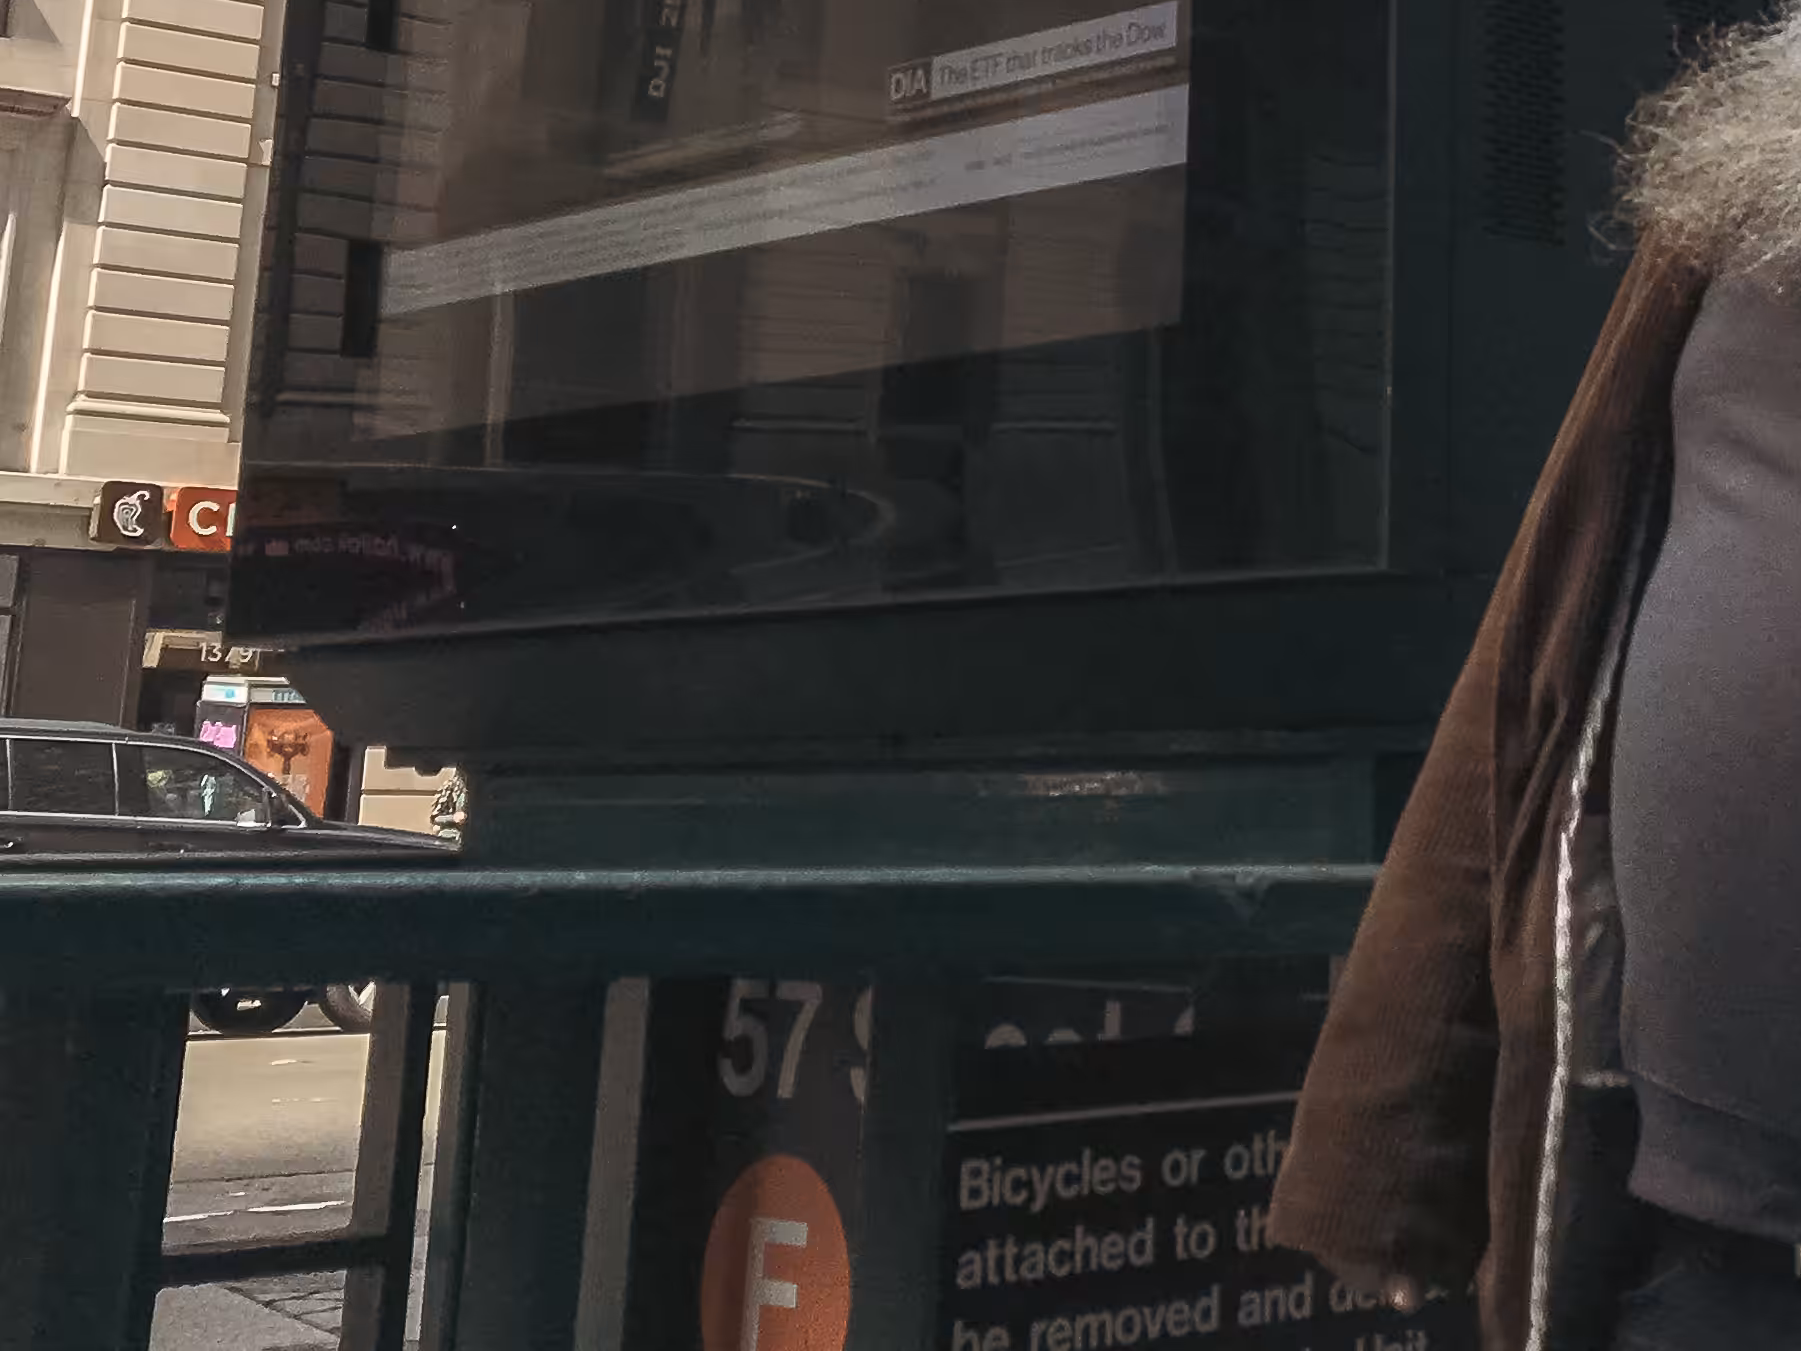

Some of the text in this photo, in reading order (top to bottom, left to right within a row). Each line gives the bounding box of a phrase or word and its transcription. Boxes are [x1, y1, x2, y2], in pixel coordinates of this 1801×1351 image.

[889, 67, 928, 103] DIA
[1094, 25, 1124, 52] the
[716, 977, 823, 1099] 57
[958, 1129, 1290, 1212] Bicycles or oth
[739, 1216, 808, 1351] F
[954, 1205, 1280, 1291] attached to th
[1027, 1282, 1222, 1351] removed
[1236, 1269, 1314, 1329] and
